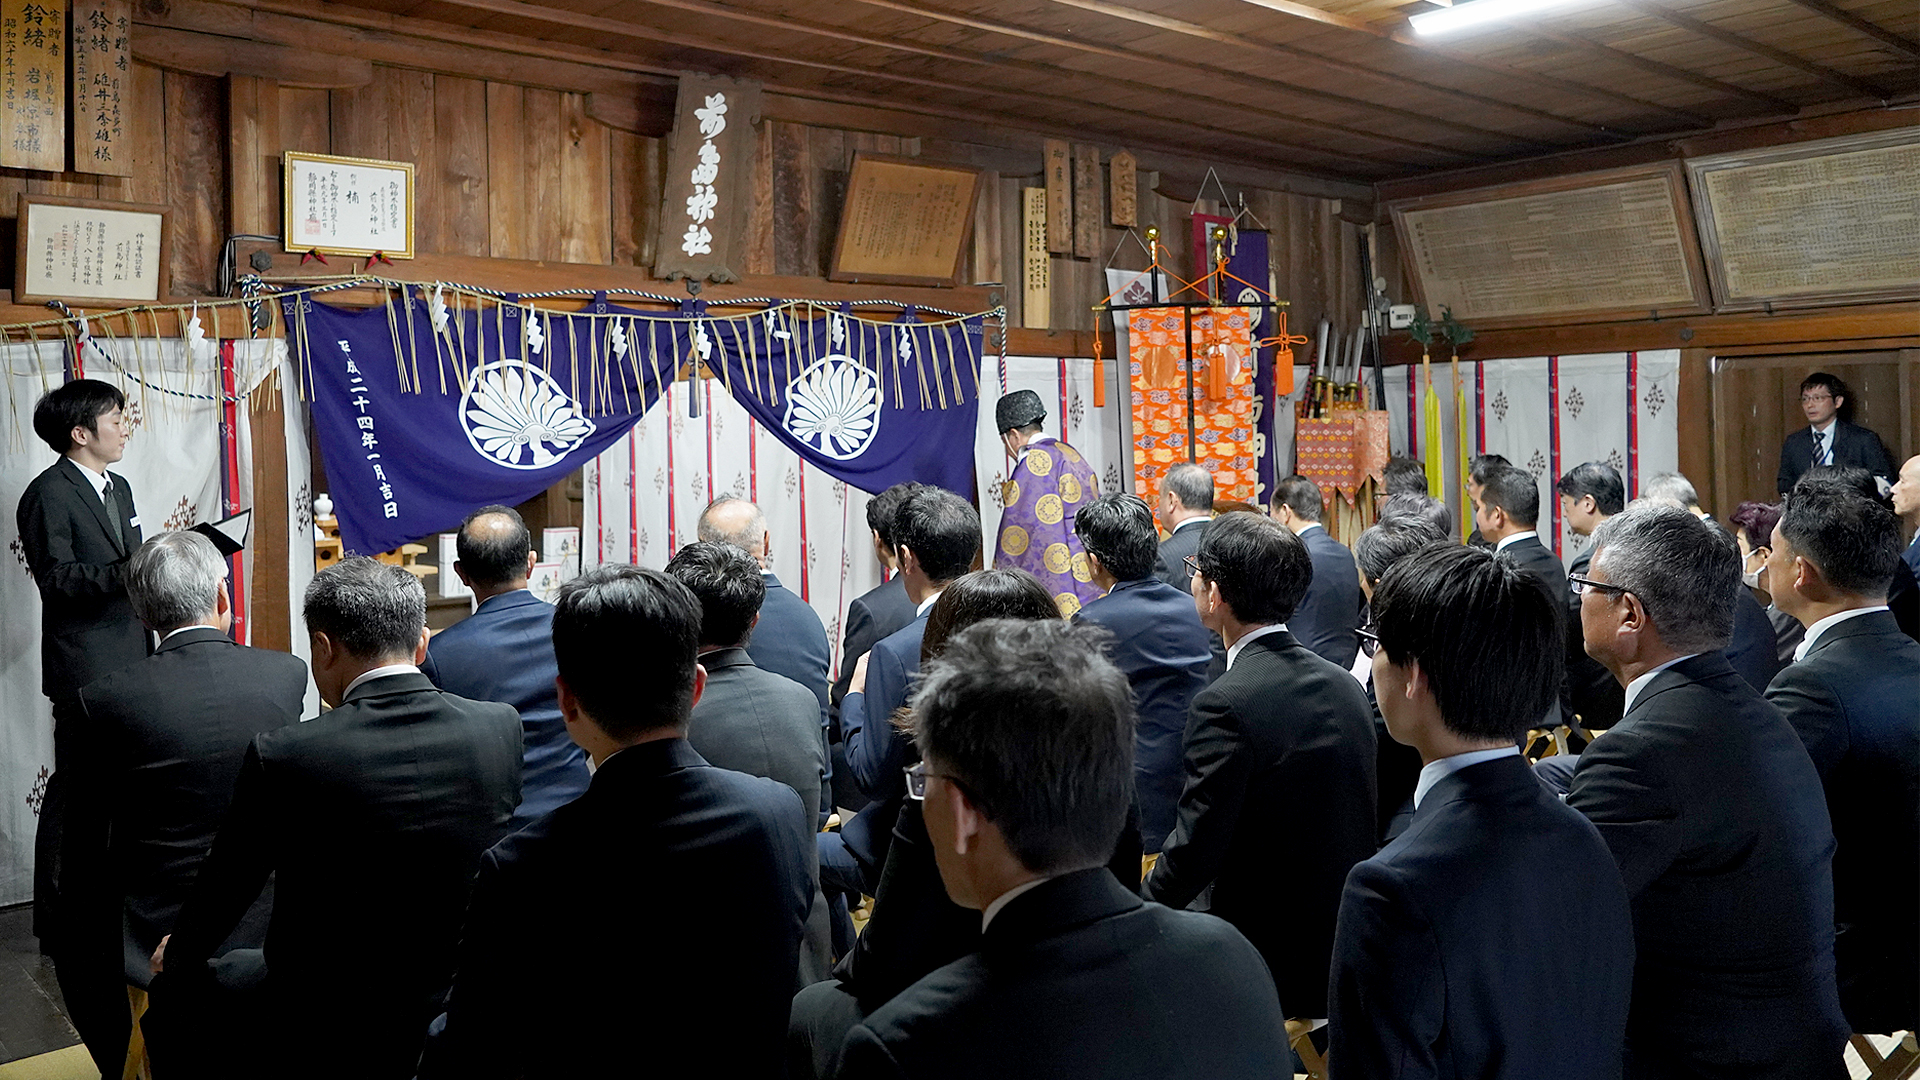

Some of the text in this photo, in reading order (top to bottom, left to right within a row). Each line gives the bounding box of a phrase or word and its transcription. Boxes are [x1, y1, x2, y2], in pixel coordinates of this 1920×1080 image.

[22, 4, 49, 49] 鈴緒
[47, 9, 62, 57] 寄贈者
[89, 10, 113, 53] 鈴緒
[115, 17, 129, 71] 寄贈者
[681, 91, 729, 257] 前島神社
[337, 339, 399, 520] 平成二十四年一月吉日
